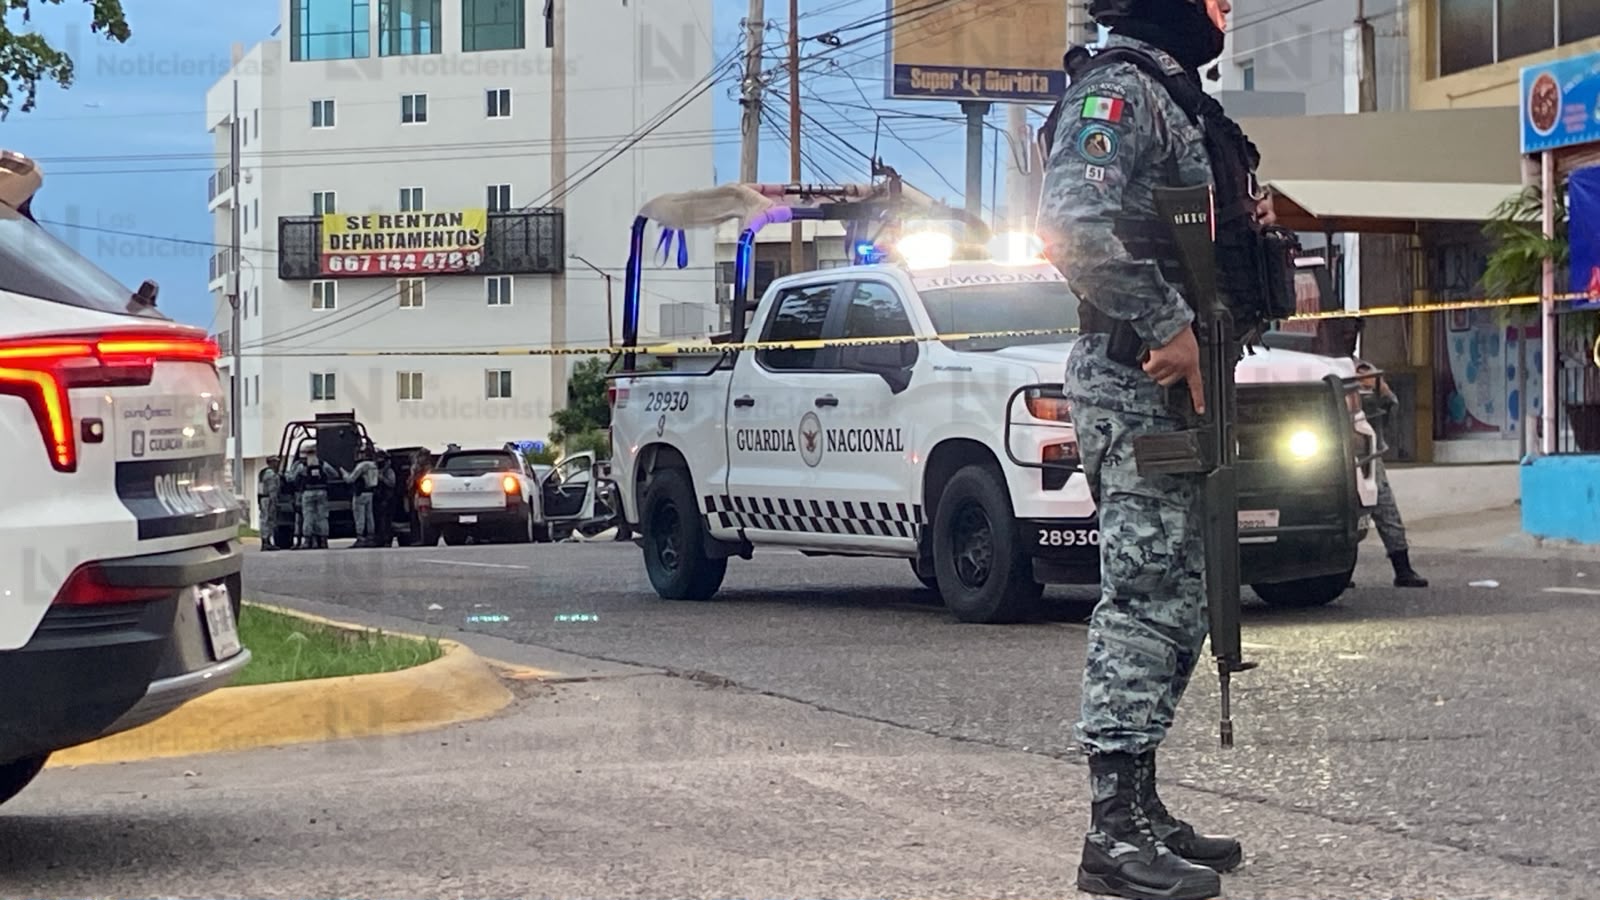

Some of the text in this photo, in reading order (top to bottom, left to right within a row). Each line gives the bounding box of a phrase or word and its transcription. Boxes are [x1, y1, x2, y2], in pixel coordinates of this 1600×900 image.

[1088, 167, 1102, 179] 51
[346, 212, 463, 230] SE RENTAN
[329, 228, 480, 251] DEPARTAMENTOS
[328, 255, 370, 272] 667
[378, 254, 417, 271] 144
[644, 391, 689, 413] 28930
[736, 427, 905, 453] GUARDIA NACIONAL
[1038, 529, 1100, 546] 28930
